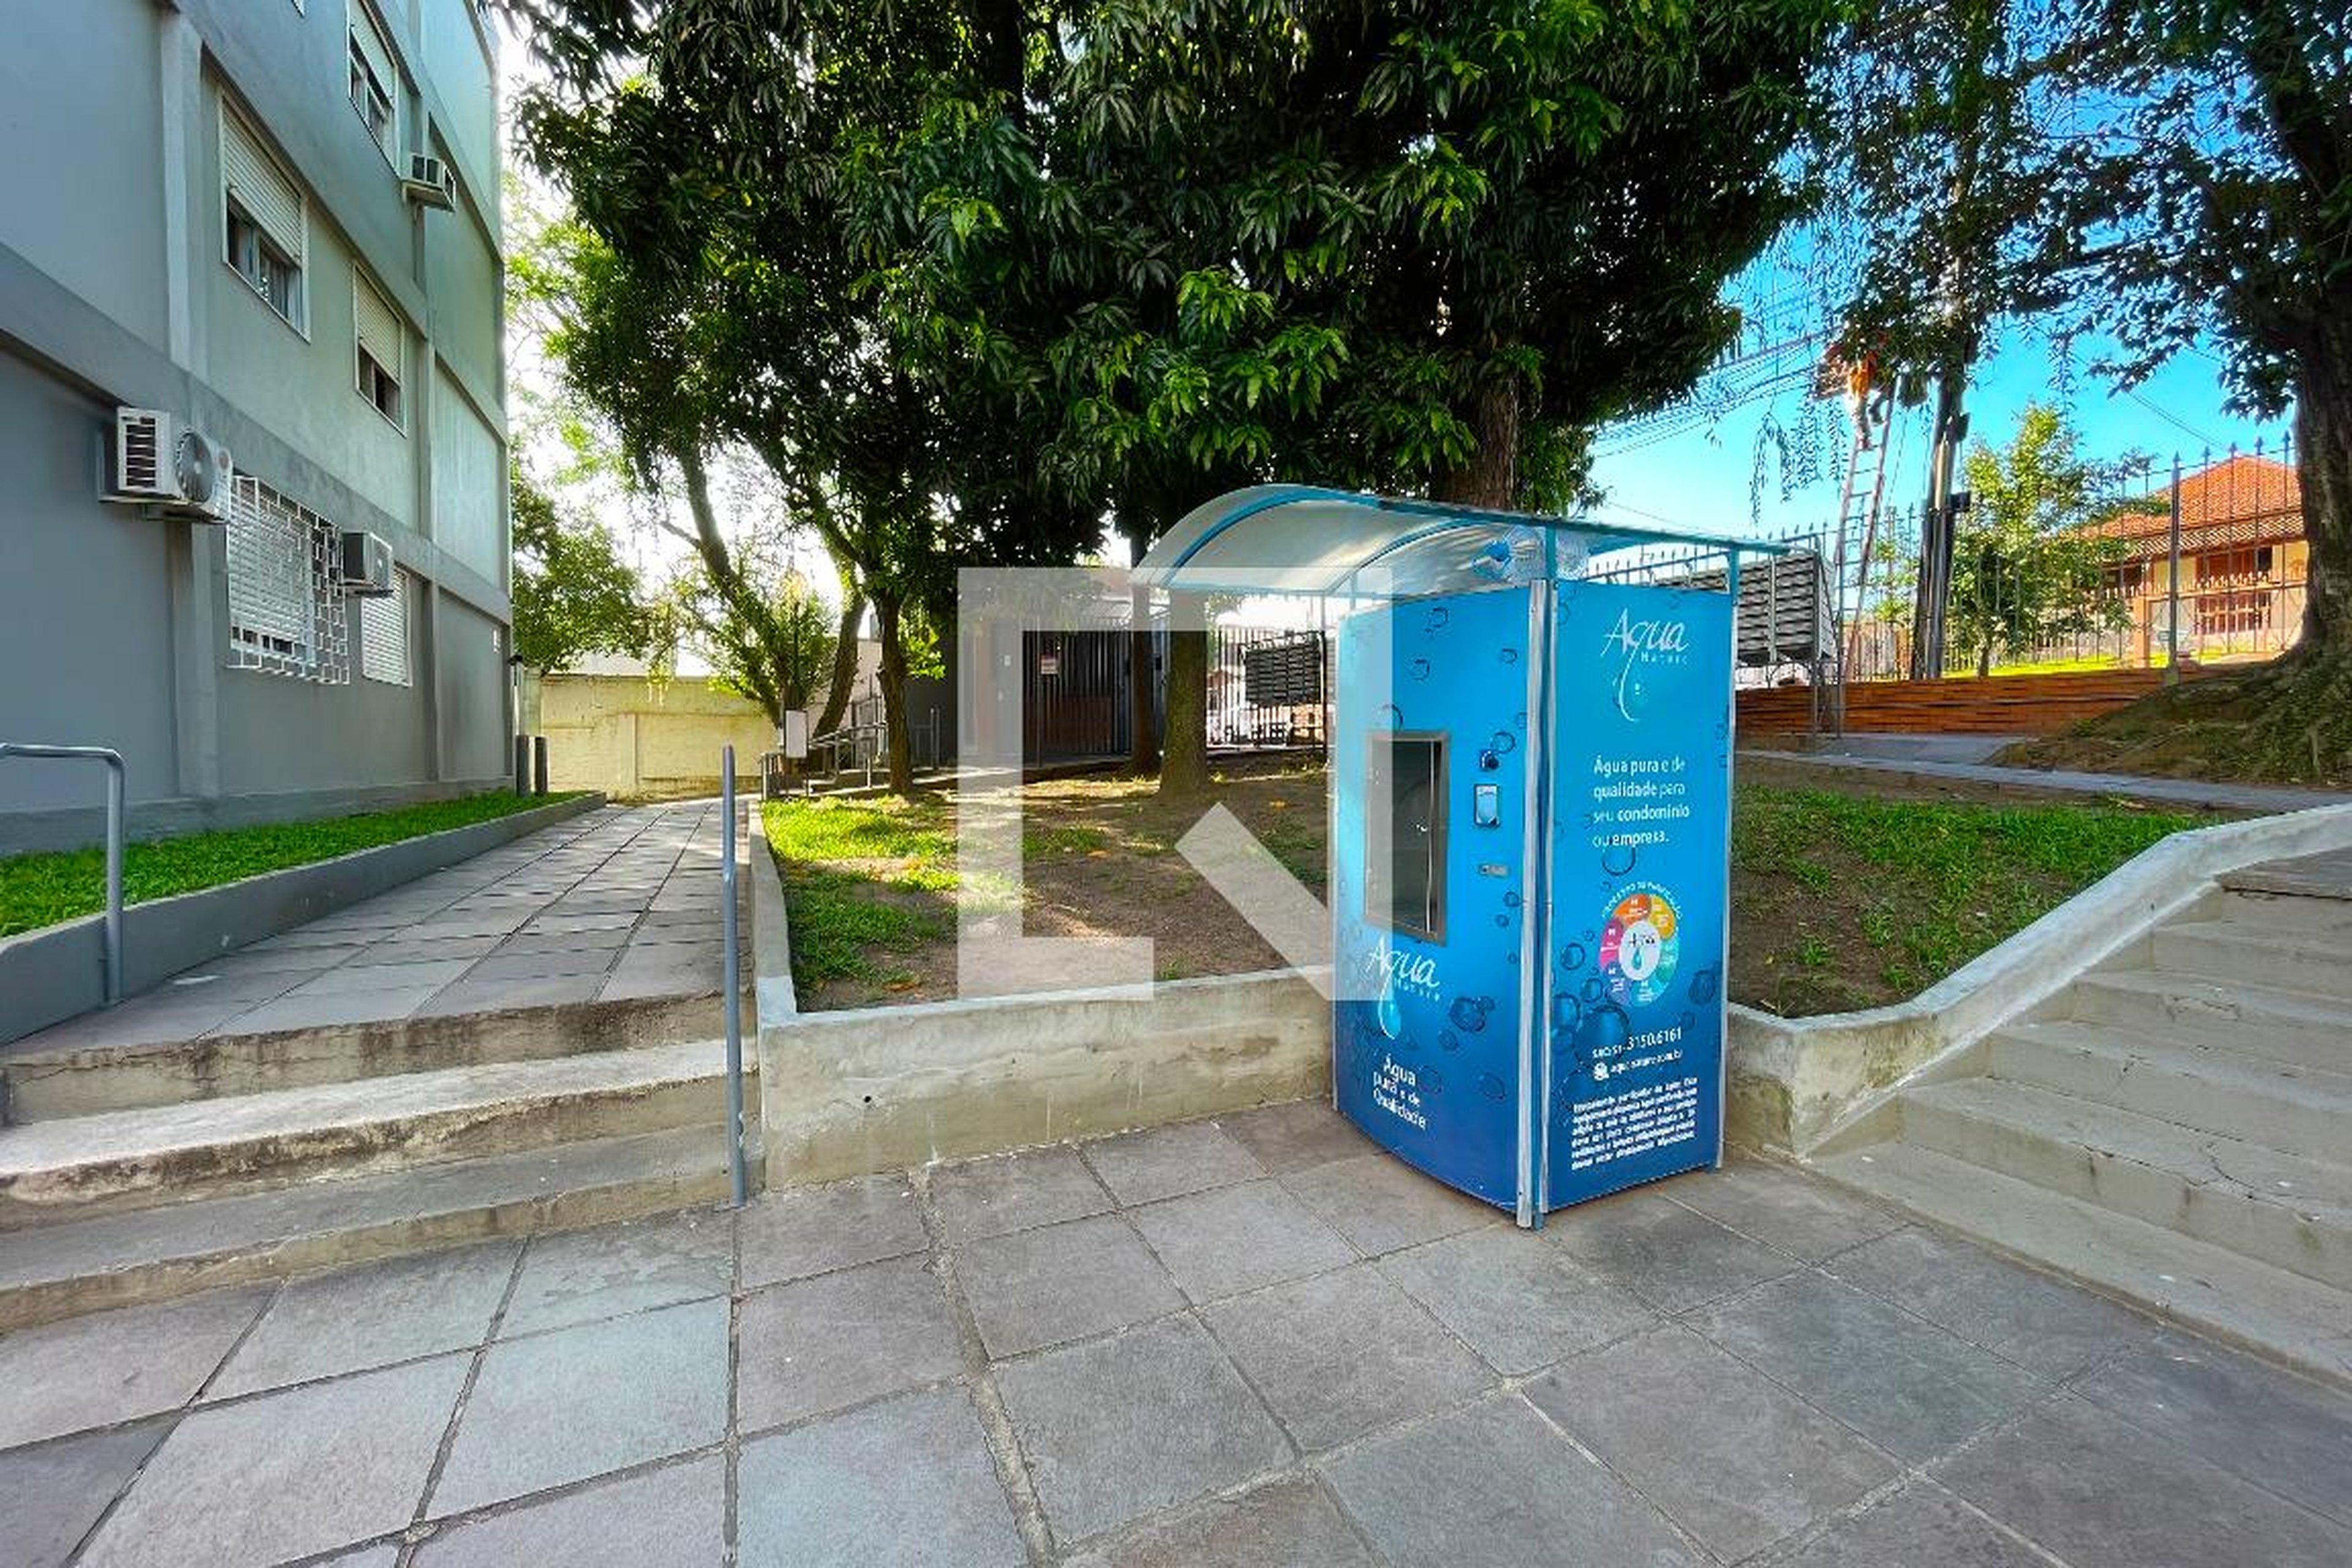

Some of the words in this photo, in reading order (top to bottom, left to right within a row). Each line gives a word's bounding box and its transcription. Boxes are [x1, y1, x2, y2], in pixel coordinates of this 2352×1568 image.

[1594, 754, 1628, 778] Água
[1630, 760, 1659, 777] pura
[1594, 780, 1657, 803] qualidade
[1660, 782, 1686, 799] para
[1384, 1054, 1415, 1087] Água
